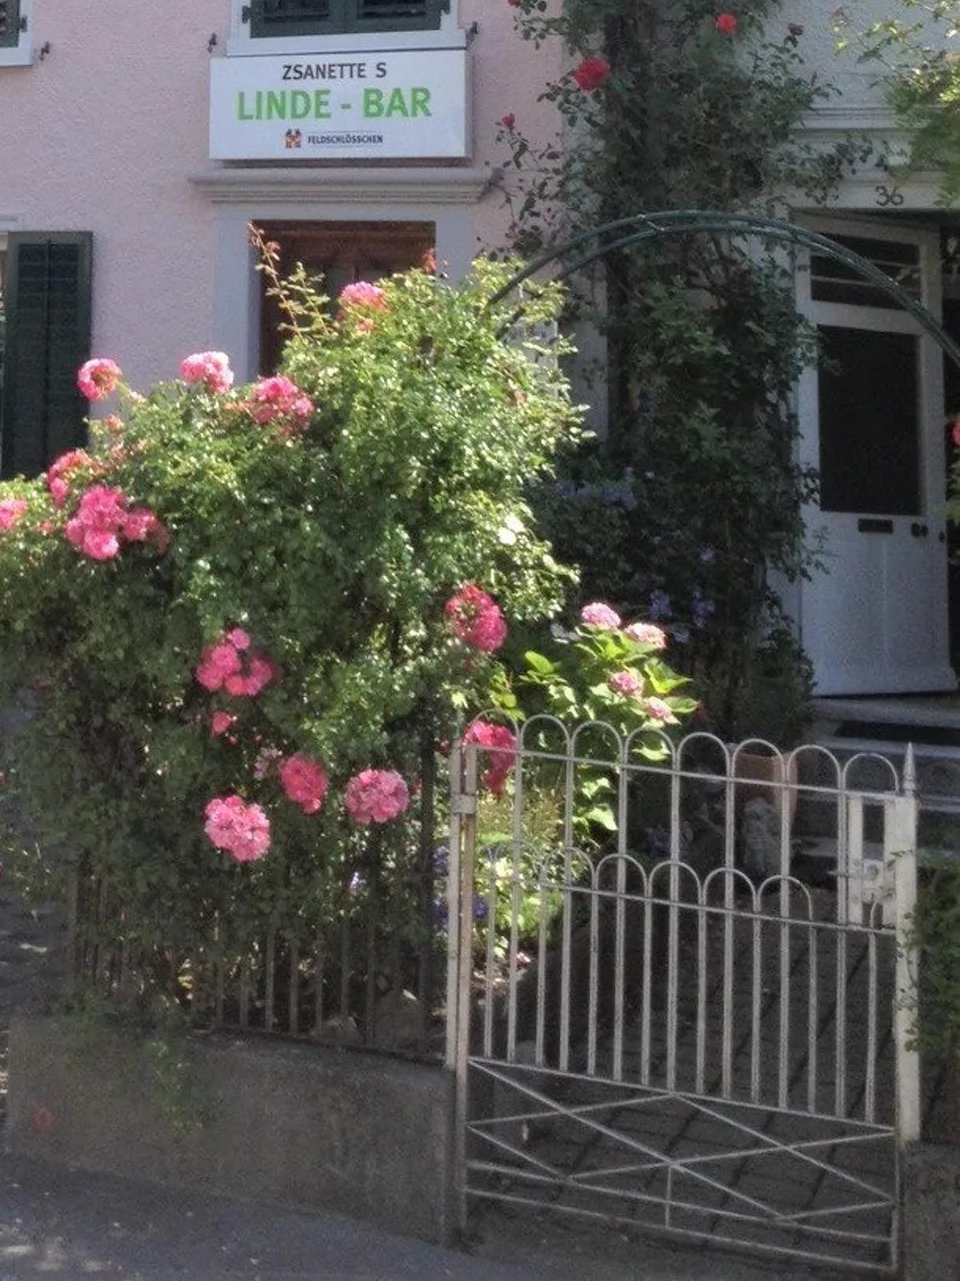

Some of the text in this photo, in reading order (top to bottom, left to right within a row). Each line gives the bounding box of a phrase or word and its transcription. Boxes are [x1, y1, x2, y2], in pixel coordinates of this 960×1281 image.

[282, 62, 387, 80] ZSANETTE S
[237, 89, 332, 121] LINDE
[363, 87, 432, 119] BAR
[875, 185, 904, 206] 36
